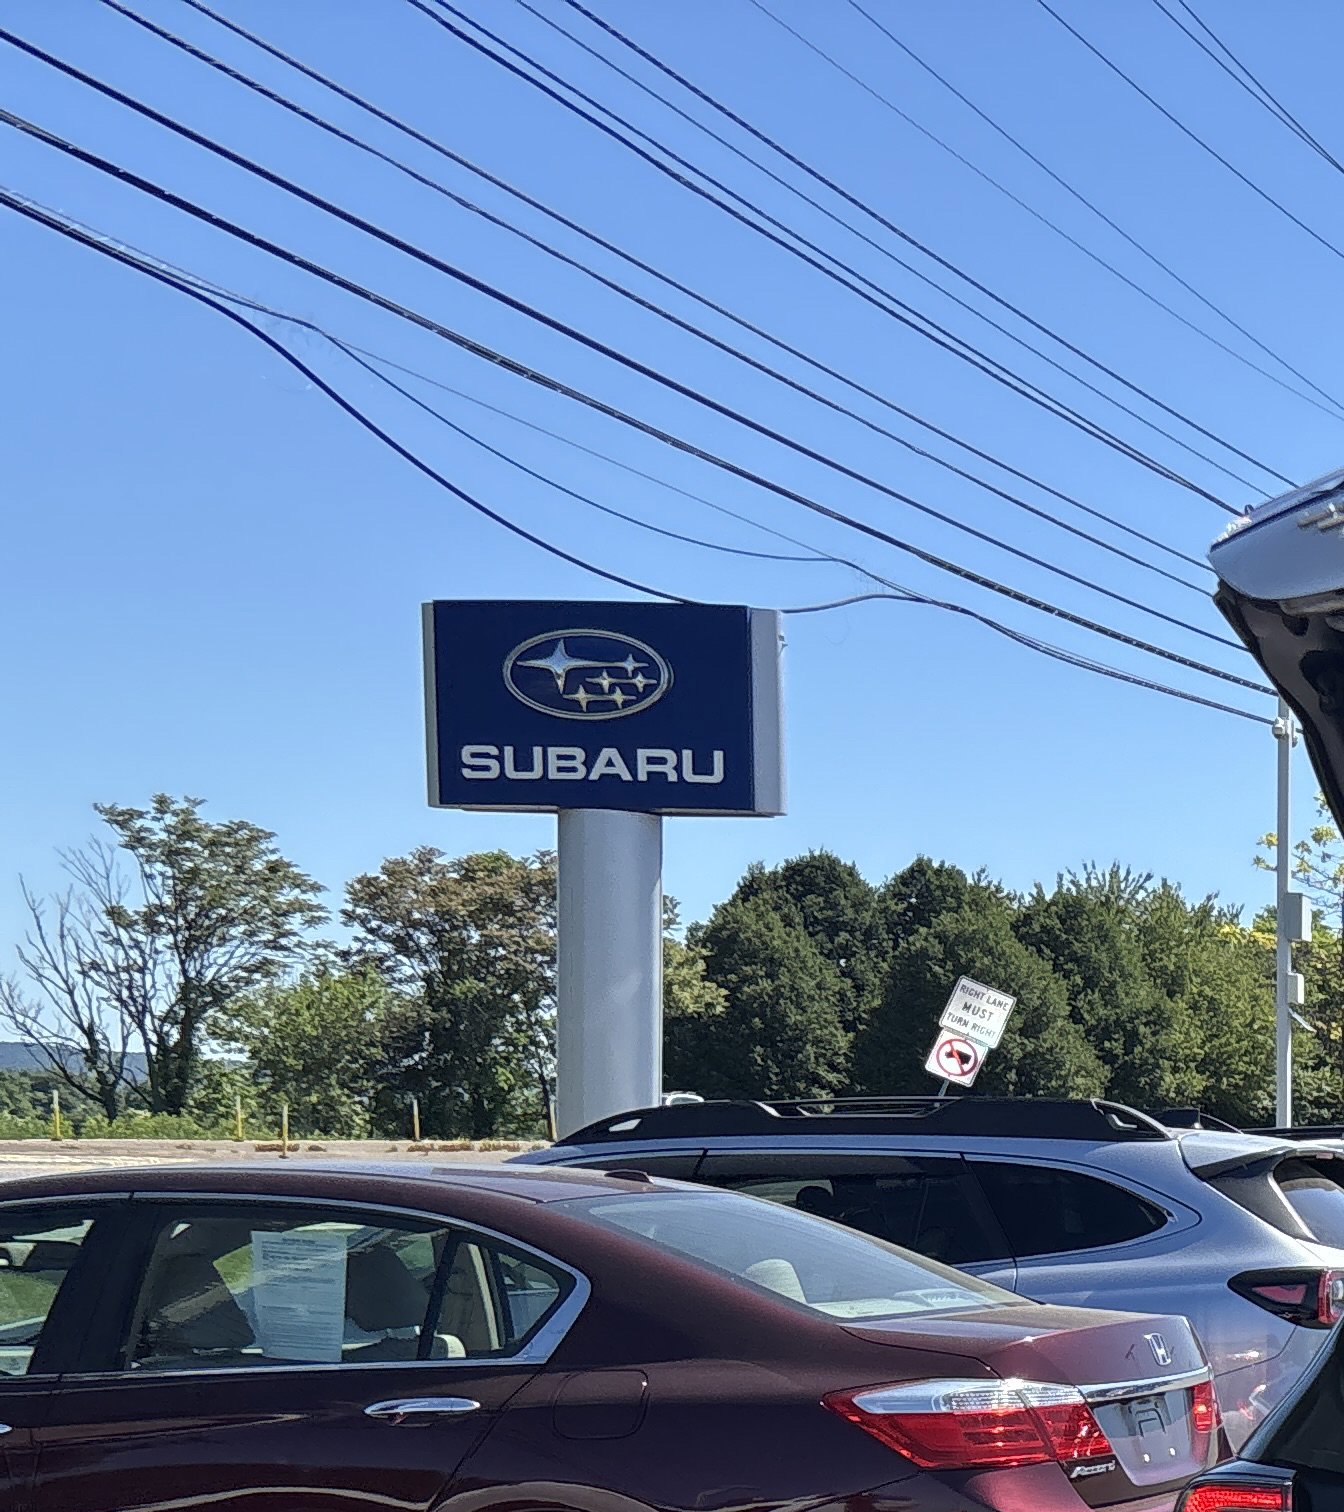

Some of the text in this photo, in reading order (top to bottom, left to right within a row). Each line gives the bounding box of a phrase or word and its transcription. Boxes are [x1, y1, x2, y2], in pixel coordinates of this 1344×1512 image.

[461, 744, 725, 784] SUBARU
[960, 985, 1009, 1011] RIGHT LANE
[962, 1002, 993, 1021] MUST
[947, 1012, 996, 1038] TURN RIGHT
